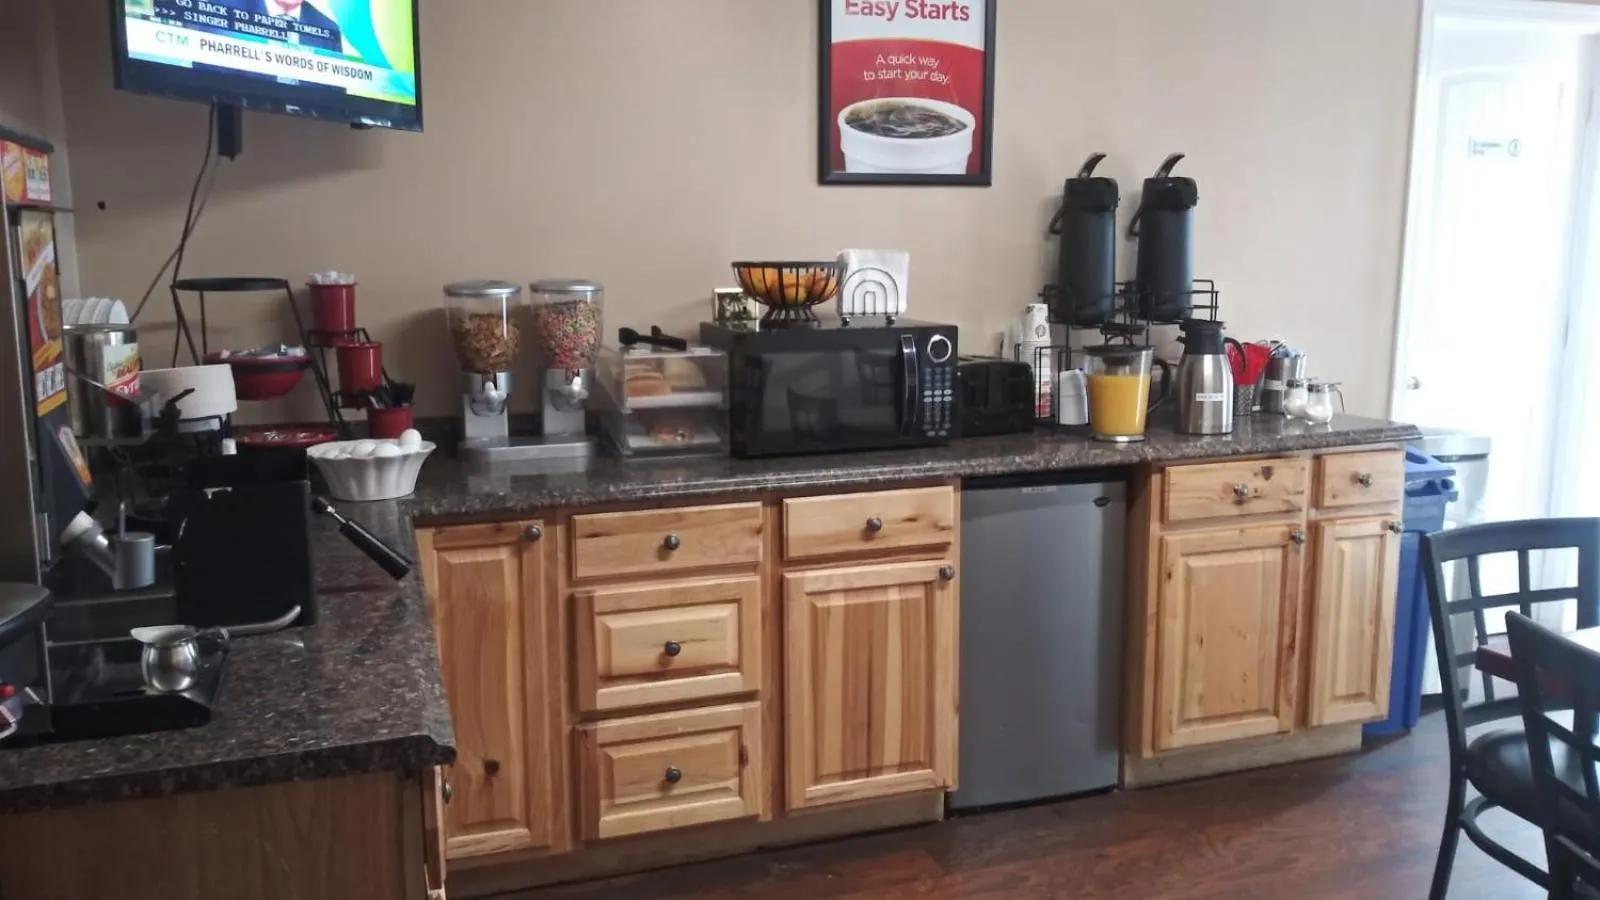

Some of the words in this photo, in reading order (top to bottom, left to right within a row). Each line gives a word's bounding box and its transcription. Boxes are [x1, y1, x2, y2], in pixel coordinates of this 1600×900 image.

[184, 11, 228, 28] SINGER
[198, 0, 228, 16] BACK
[233, 9, 249, 20] TO
[254, 14, 287, 29] PAPER
[845, 0, 899, 21] Easy
[904, 0, 970, 21] Starts
[156, 30, 189, 46] CTM
[200, 38, 273, 63] PHARRELL'S
[275, 53, 314, 71] WORDS
[316, 60, 329, 73] OF
[331, 64, 374, 82] WISDOM
[875, 54, 886, 65] A
[887, 53, 916, 66] quick
[918, 56, 940, 69] way
[863, 70, 876, 81] to
[877, 68, 902, 80] start
[904, 69, 929, 81] your
